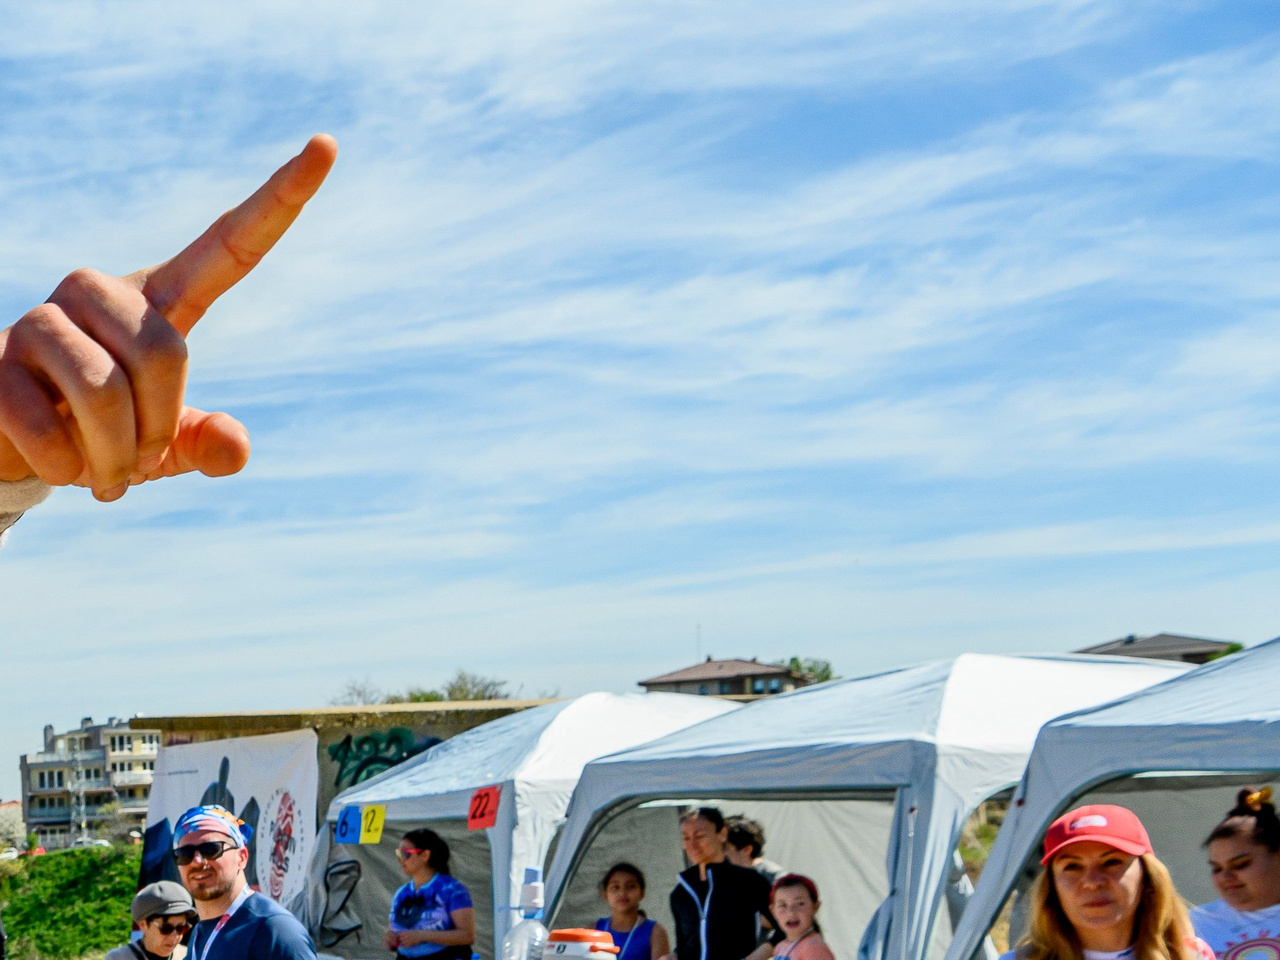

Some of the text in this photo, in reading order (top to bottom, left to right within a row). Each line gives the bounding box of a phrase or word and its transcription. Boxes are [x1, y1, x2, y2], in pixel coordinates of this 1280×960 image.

[471, 792, 490, 819] 22
[339, 810, 349, 838] 6
[364, 809, 376, 833] 12
